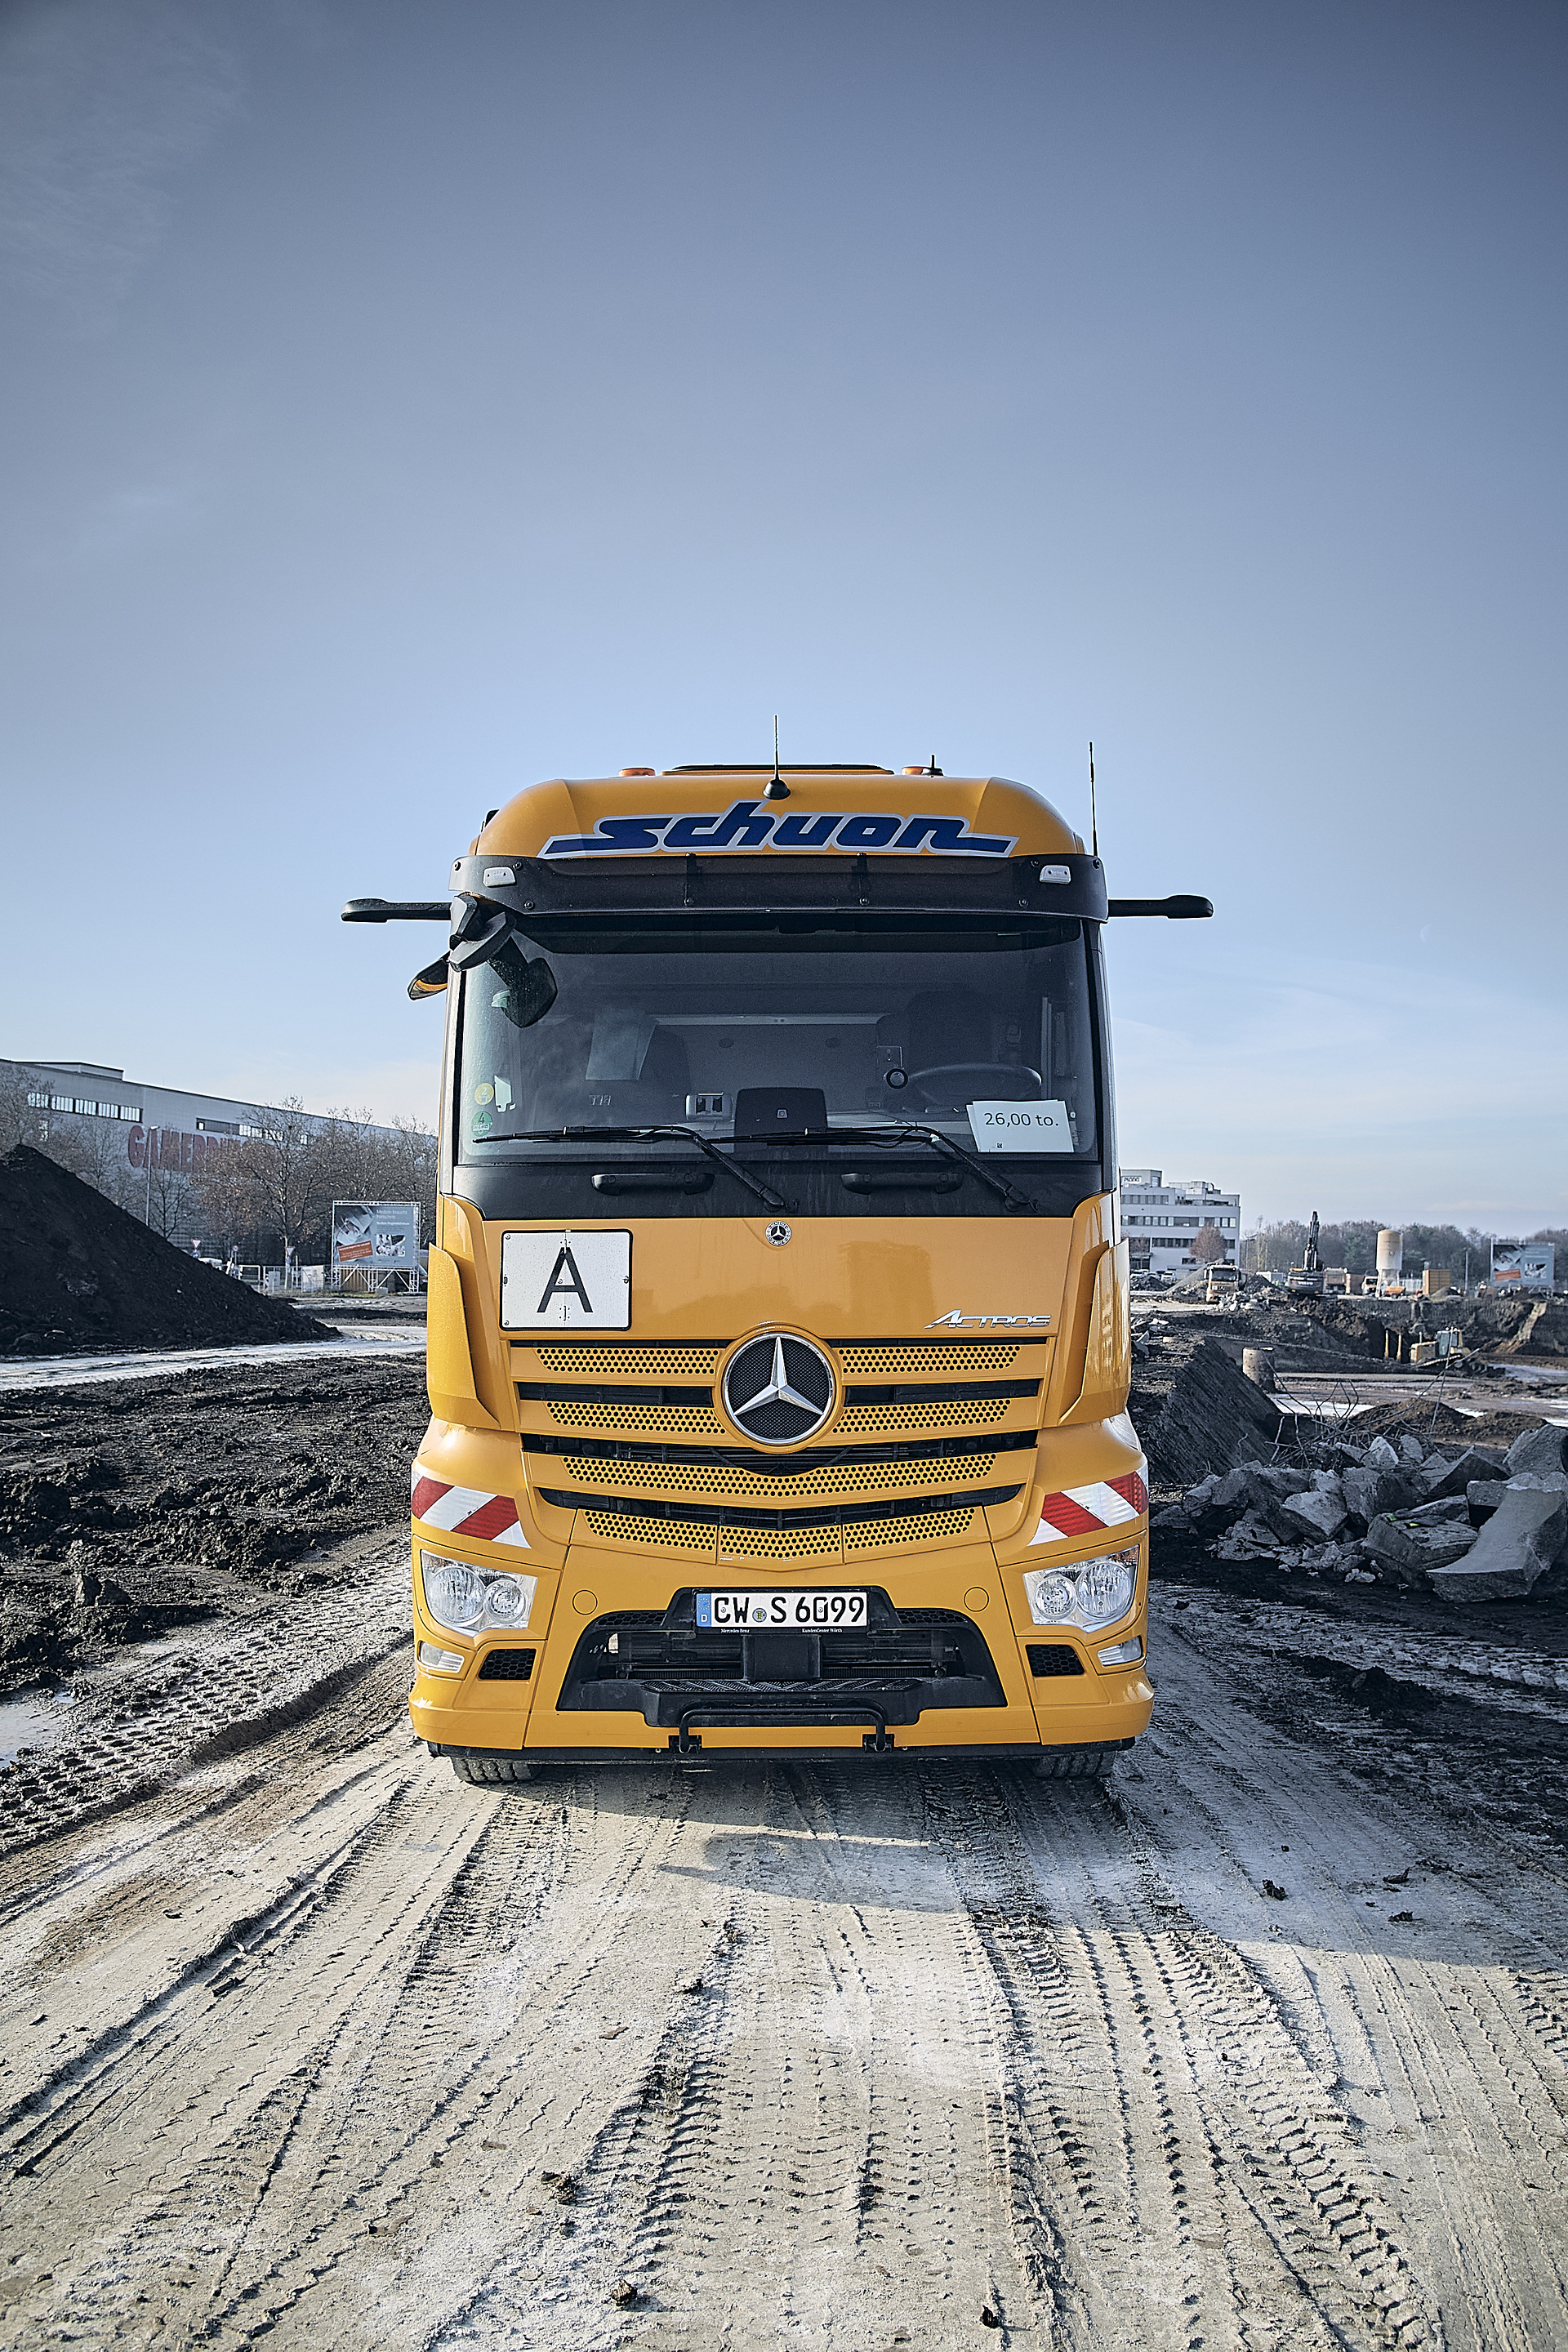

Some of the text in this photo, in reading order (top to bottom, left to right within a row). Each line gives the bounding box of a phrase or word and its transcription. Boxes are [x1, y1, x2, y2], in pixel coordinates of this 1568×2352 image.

[539, 799, 1017, 857] schuon
[479, 1112, 485, 1123] 4
[983, 1112, 1059, 1128] 26,00 to.
[537, 1247, 594, 1313] A
[924, 1309, 1051, 1329] ACTROS
[701, 1597, 864, 1623] D CW S 6099
